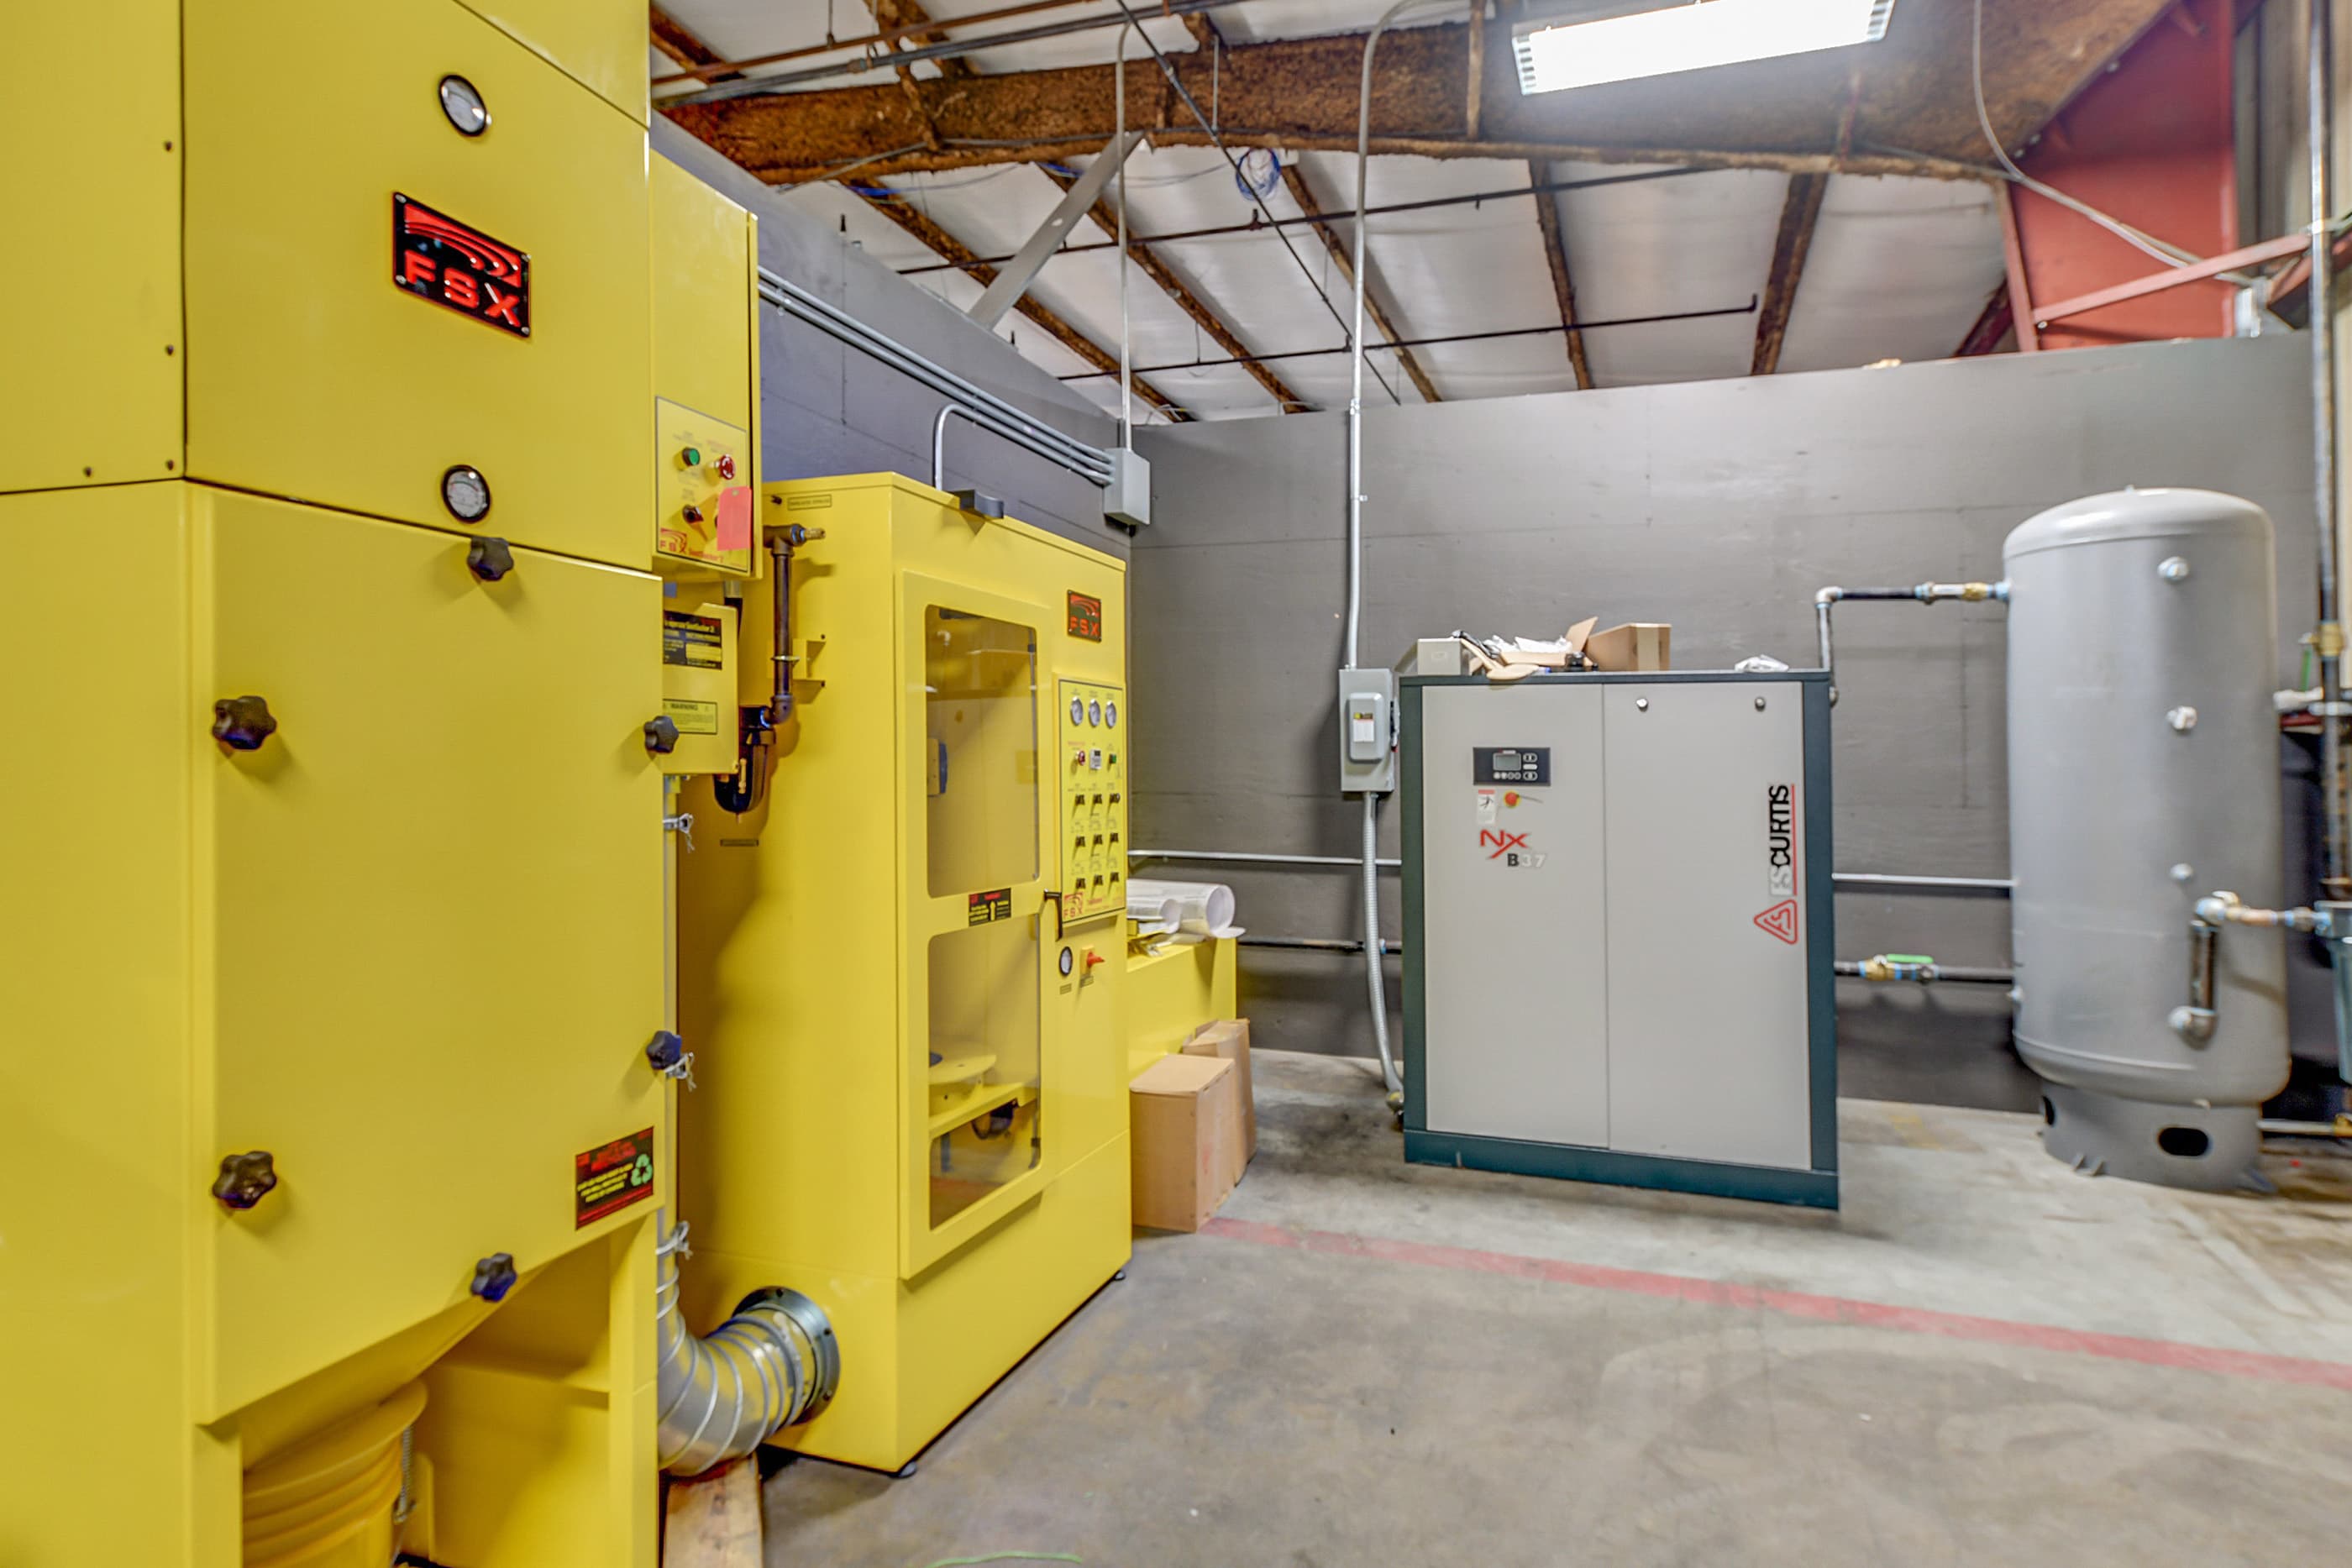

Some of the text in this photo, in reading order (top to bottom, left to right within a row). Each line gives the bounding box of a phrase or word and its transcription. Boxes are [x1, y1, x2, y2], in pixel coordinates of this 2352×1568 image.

[404, 249, 521, 328] FSX
[1070, 615, 1100, 637] FSX
[1479, 828, 1532, 860] NX
[1507, 852, 1546, 868] B37
